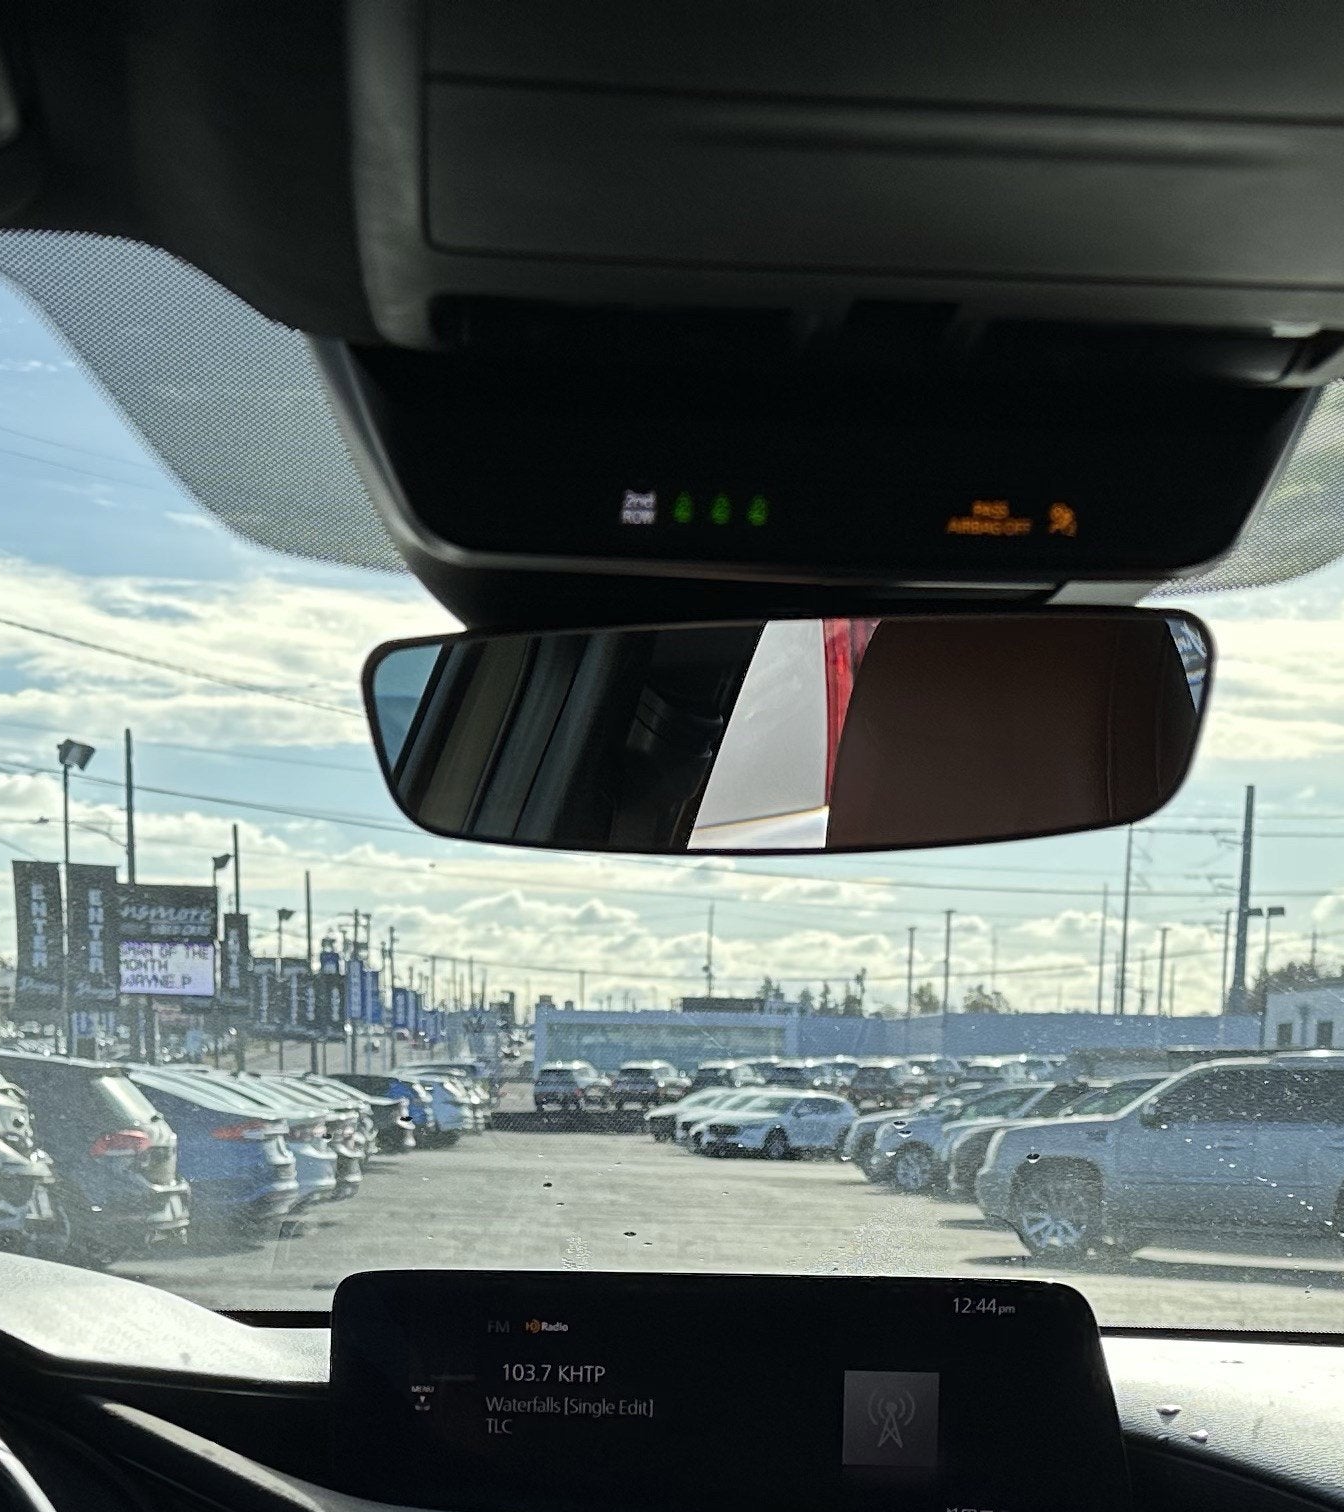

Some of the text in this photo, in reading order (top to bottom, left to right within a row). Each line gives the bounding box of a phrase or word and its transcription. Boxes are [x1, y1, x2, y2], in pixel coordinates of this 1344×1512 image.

[487, 1322, 510, 1333] FM
[541, 1322, 568, 1332] Radio
[502, 1363, 606, 1382] 103.7 KHTP
[486, 1396, 561, 1414] Waterfalls
[486, 1419, 512, 1434] TLC
